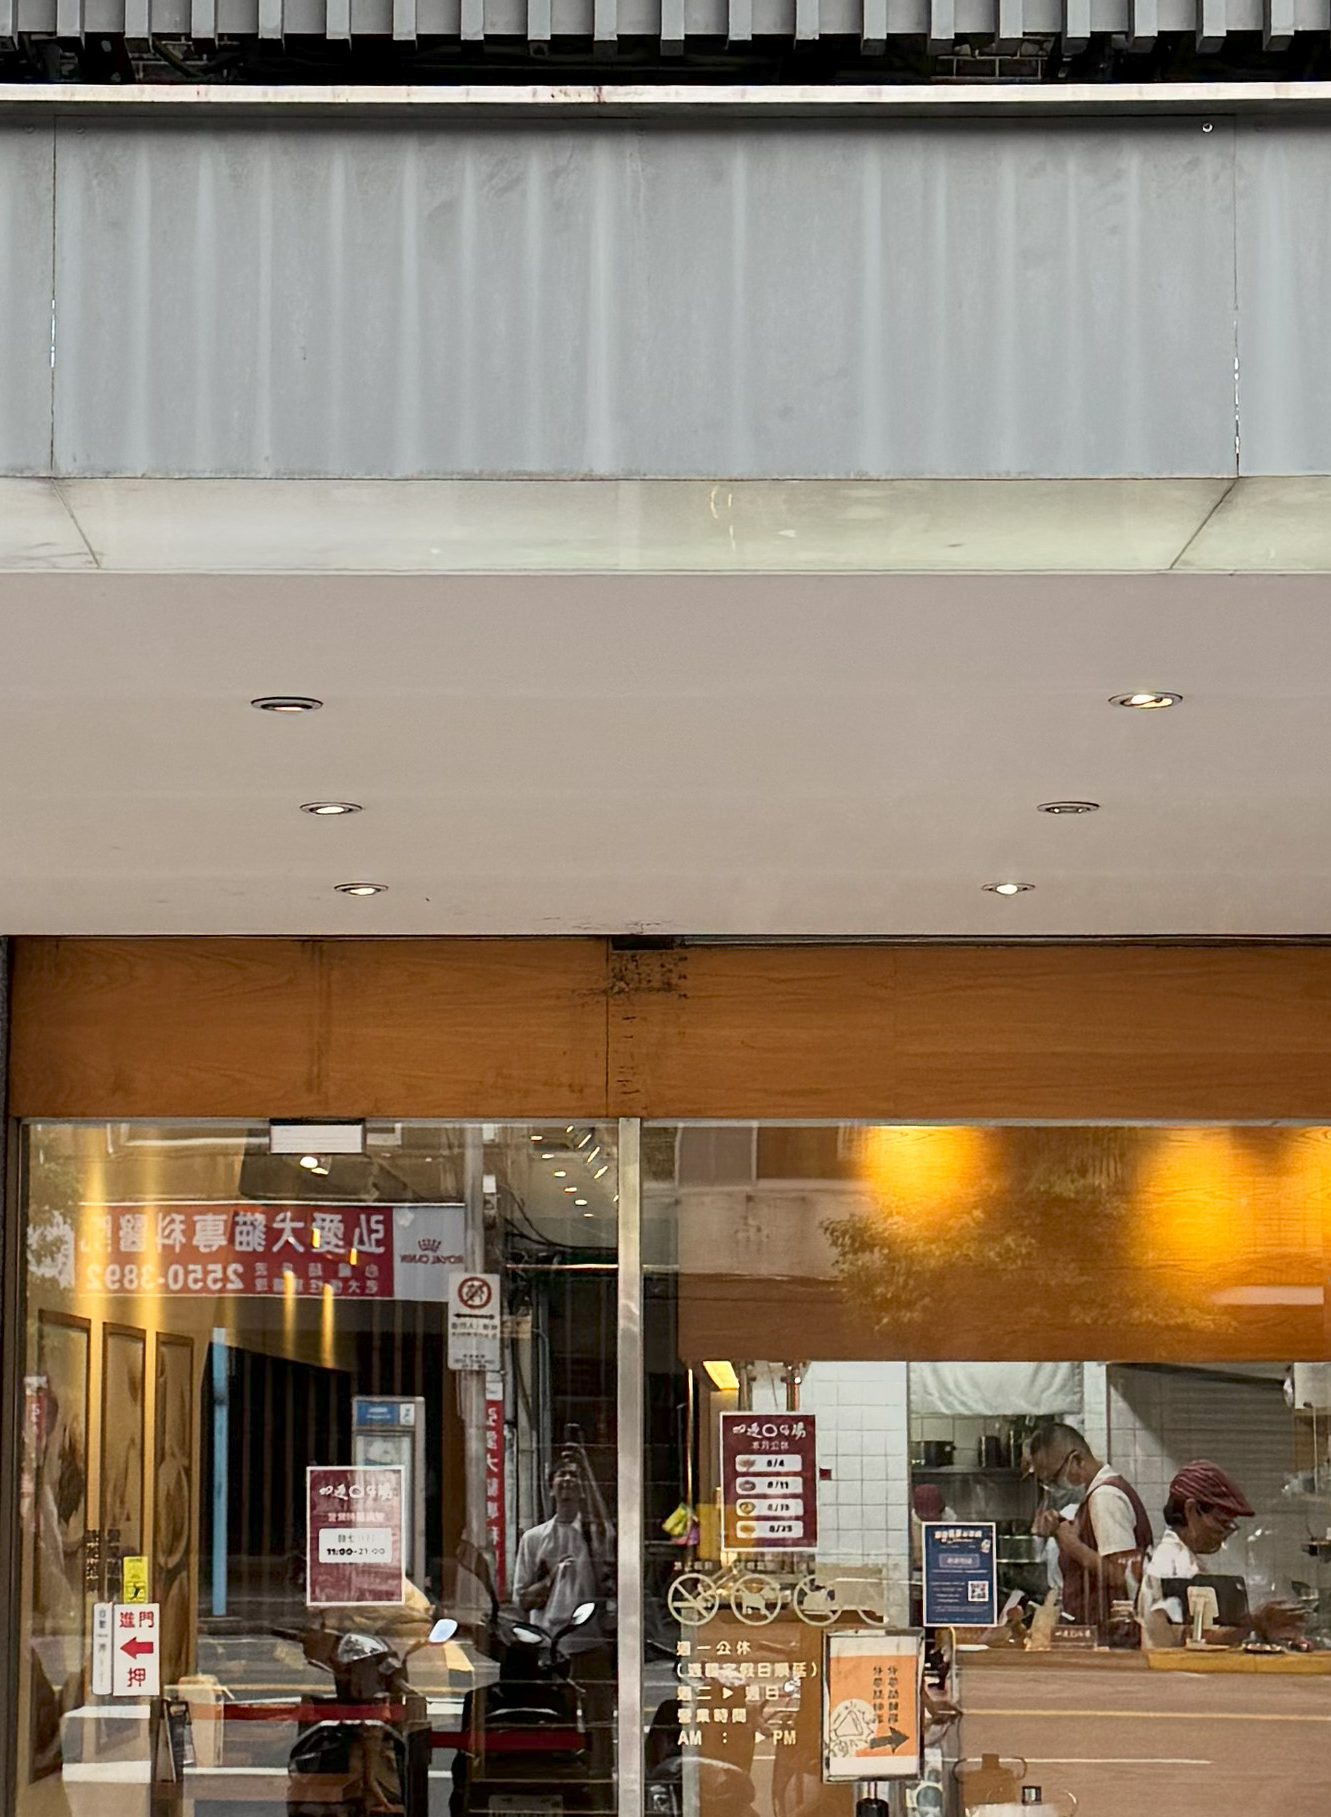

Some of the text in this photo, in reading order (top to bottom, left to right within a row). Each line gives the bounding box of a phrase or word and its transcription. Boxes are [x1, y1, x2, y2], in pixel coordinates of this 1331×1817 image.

[120, 1611, 155, 1628] 進門
[127, 1668, 146, 1687] 押
[677, 1730, 702, 1746] AM
[773, 1730, 796, 1746] PM
